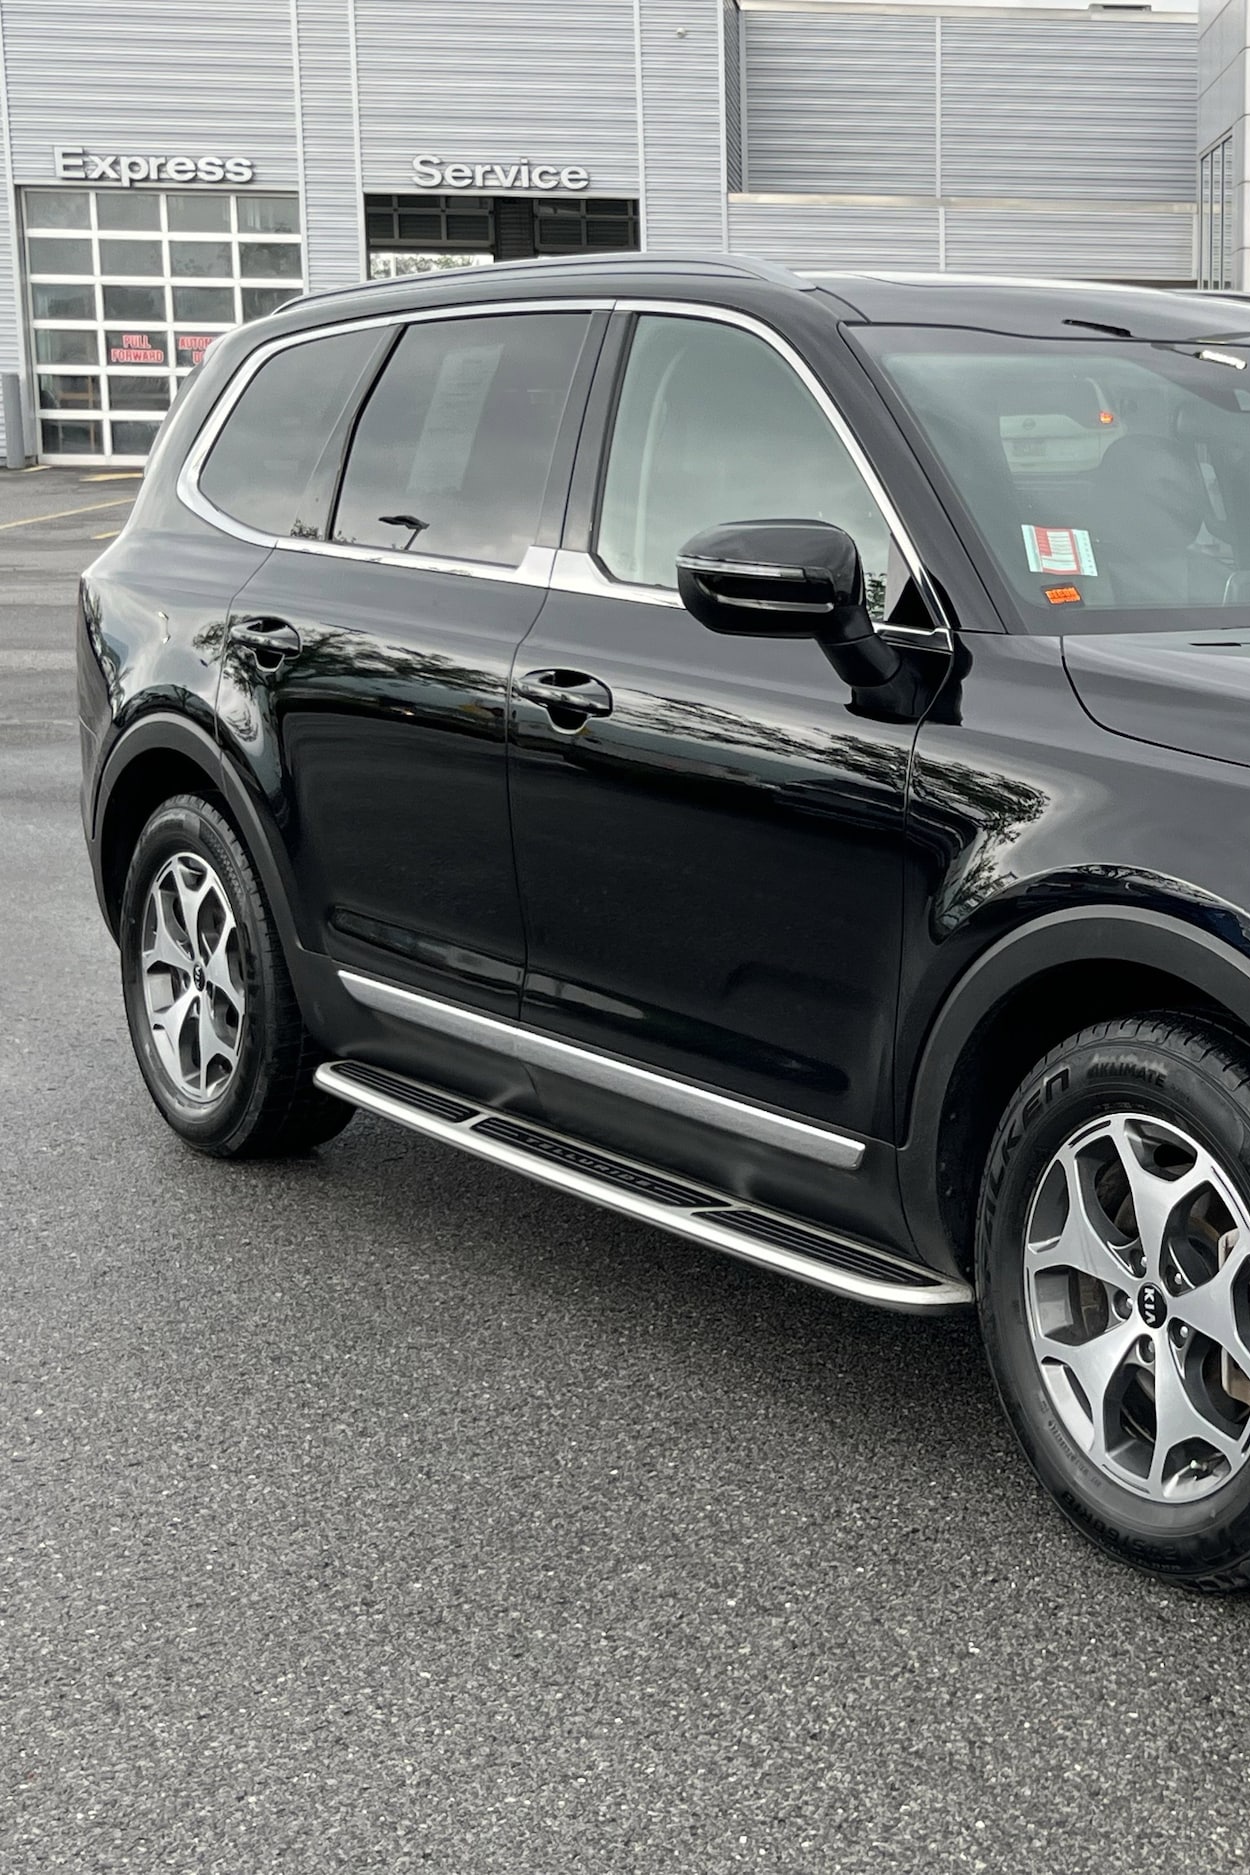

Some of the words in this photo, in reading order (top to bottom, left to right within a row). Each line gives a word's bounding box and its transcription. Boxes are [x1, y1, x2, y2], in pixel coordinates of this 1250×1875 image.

[54, 146, 254, 187] Express
[411, 154, 589, 190] Service
[110, 348, 164, 363] FORWARD
[122, 334, 152, 349] PULL
[1143, 1287, 1156, 1325] KIA
